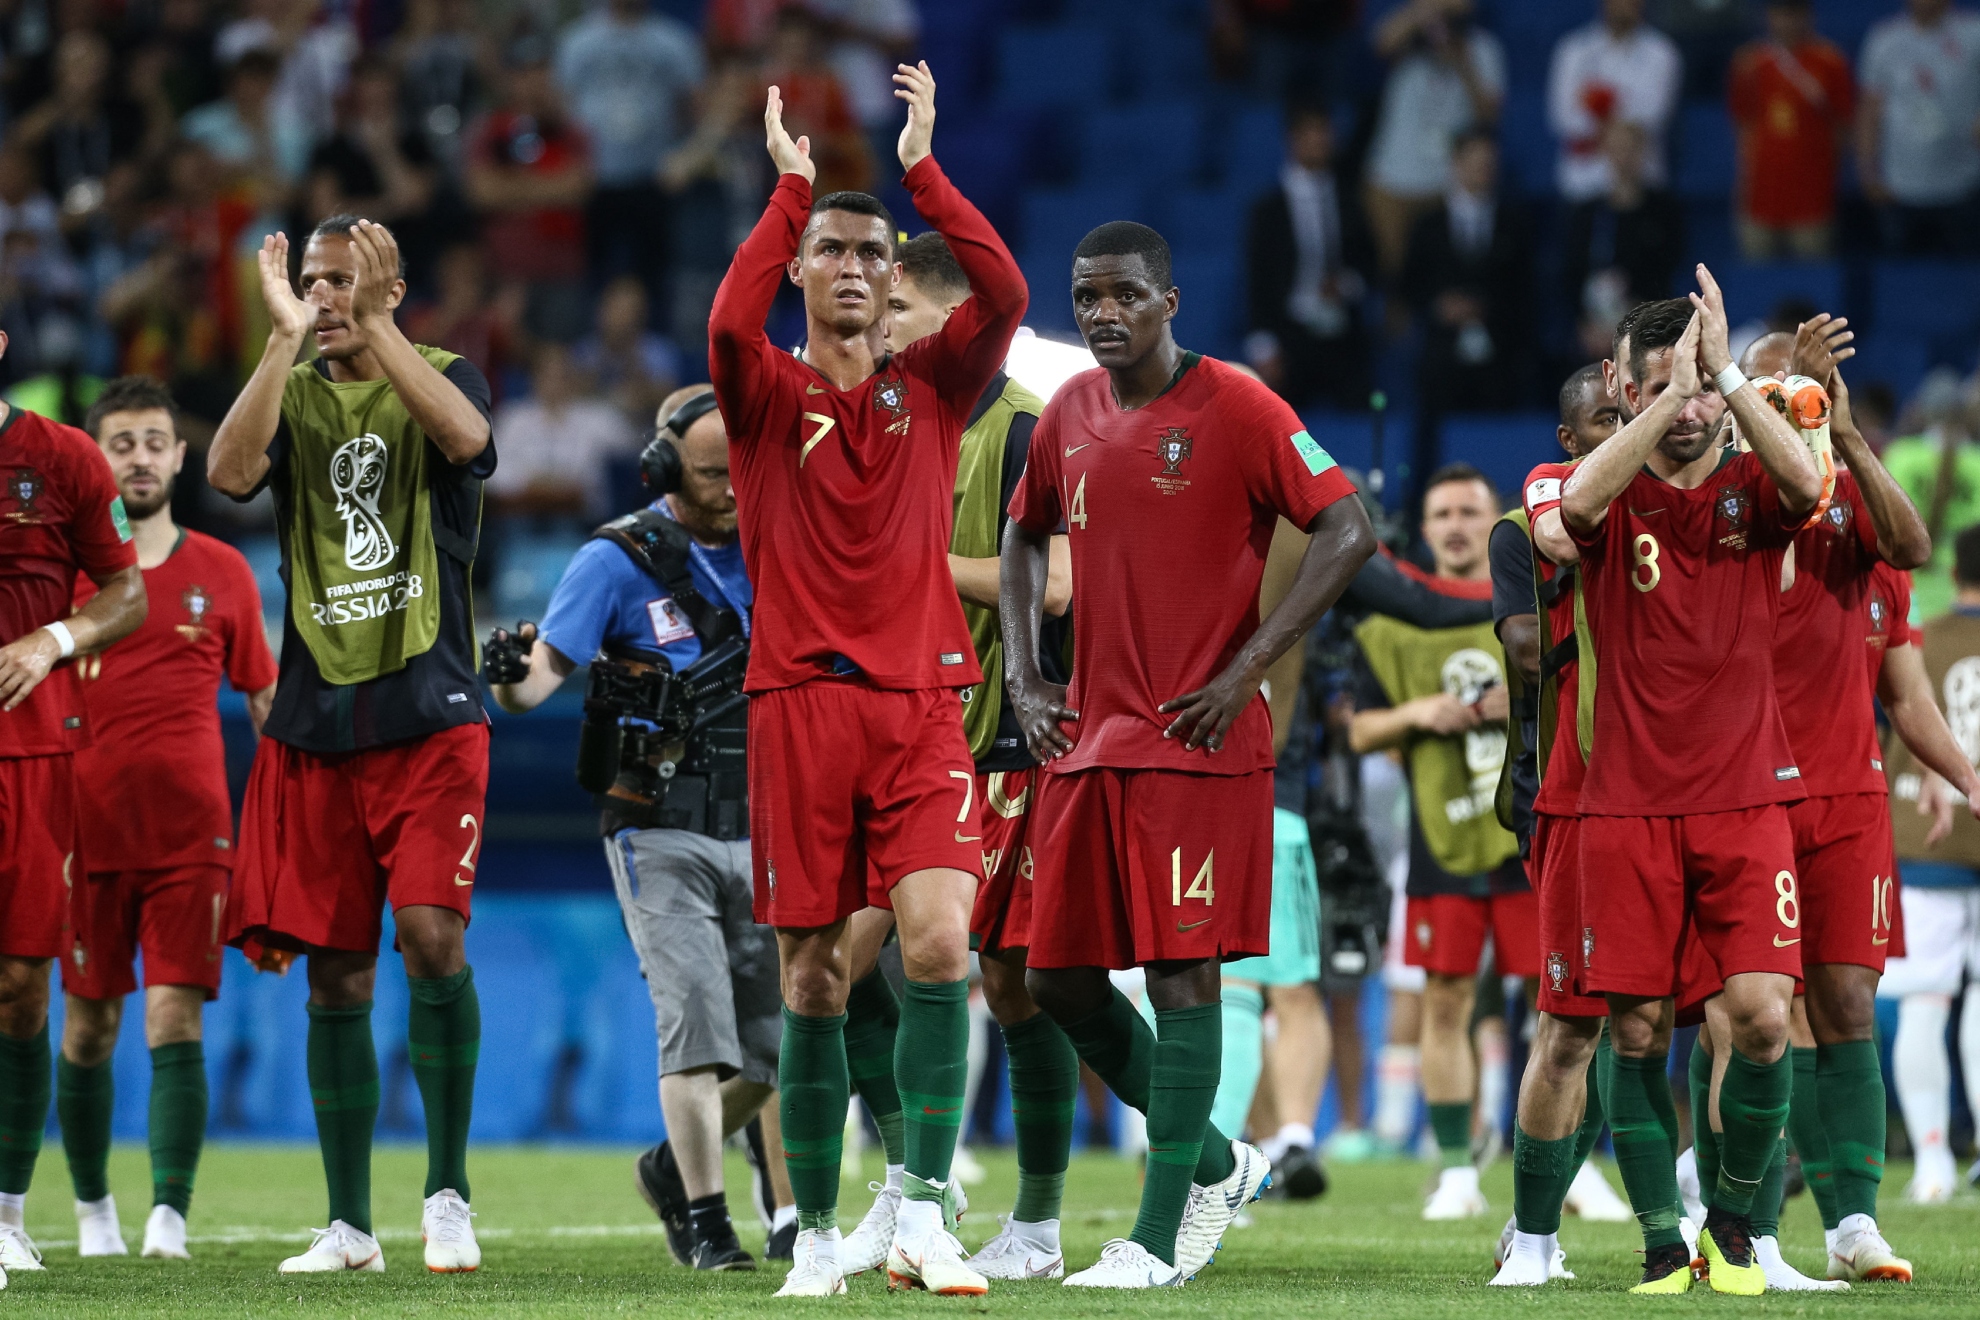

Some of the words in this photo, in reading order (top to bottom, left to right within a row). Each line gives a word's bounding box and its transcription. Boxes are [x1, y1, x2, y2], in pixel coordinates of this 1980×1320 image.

[800, 411, 836, 469] 7
[326, 583, 354, 599] FIFA
[351, 575, 396, 594] WORLD
[395, 570, 411, 583] CU
[1631, 533, 1661, 593] 8
[310, 592, 393, 626] RUSSIA
[948, 770, 973, 823] 7
[459, 813, 478, 873] 2
[1171, 846, 1215, 906] 14
[1775, 870, 1799, 929] 8
[1872, 874, 1893, 931] 10
